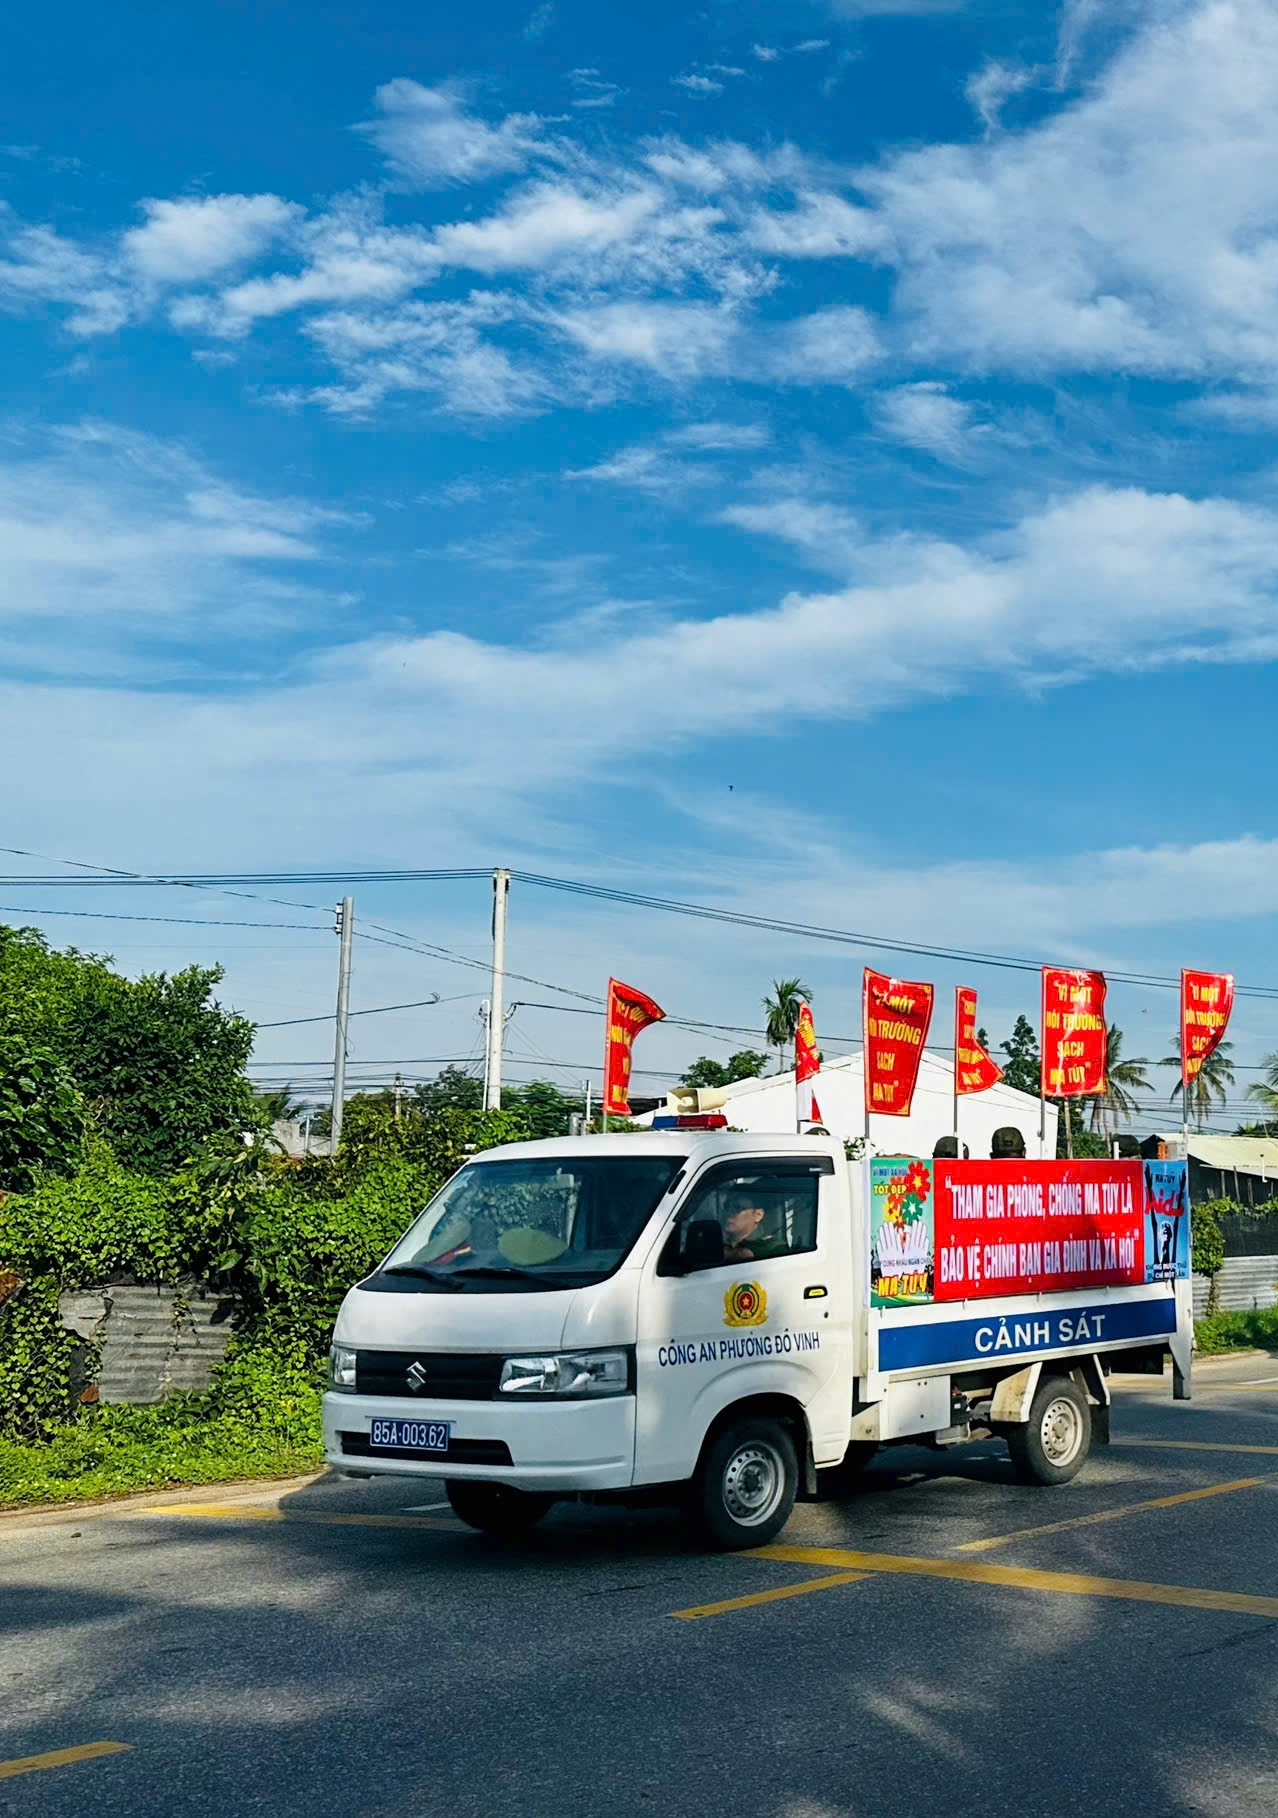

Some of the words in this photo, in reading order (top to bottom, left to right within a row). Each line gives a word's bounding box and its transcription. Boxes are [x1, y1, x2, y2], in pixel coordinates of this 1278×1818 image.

[986, 1184, 1004, 1218] GIA
[1049, 1168, 1082, 1216] CHỐNG
[1084, 1183, 1100, 1215] MA
[1102, 1176, 1120, 1214] TÚY
[1121, 1176, 1133, 1213] LÀ
[941, 1234, 963, 1283] BẢO
[967, 1238, 981, 1288] VỆ
[983, 1236, 1017, 1279] CHÍNH
[1019, 1242, 1041, 1283] BẠN
[1043, 1241, 1060, 1274] GIA
[1063, 1233, 1087, 1273] ĐÌNH
[1089, 1232, 1102, 1270] VÀ
[1104, 1232, 1117, 1269] XÃ
[878, 1275, 898, 1297] MA
[658, 1339, 697, 1367] CÔNG
[699, 1341, 717, 1362] AN
[720, 1331, 772, 1360] PHƯỜNG
[775, 1328, 792, 1354] ĐÔ
[794, 1331, 820, 1351] VINH
[974, 1317, 1050, 1352] CẢNH
[1058, 1311, 1106, 1342] SÁT
